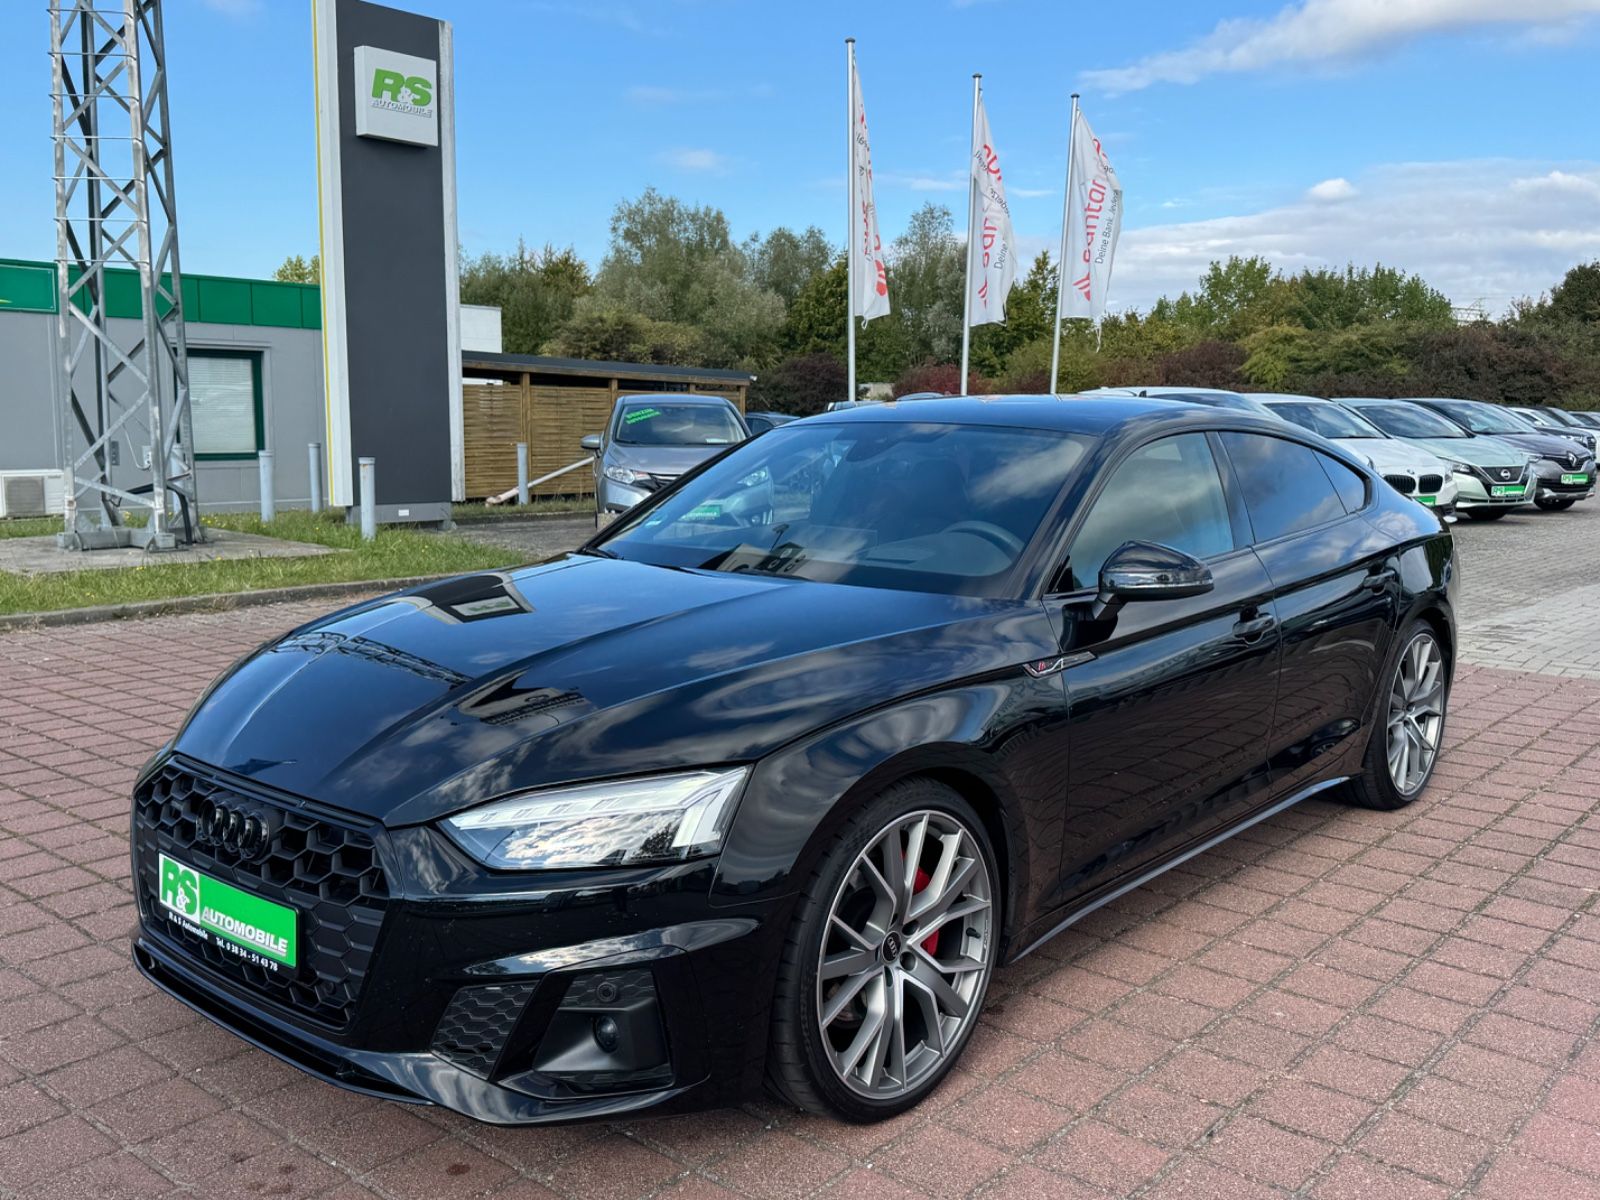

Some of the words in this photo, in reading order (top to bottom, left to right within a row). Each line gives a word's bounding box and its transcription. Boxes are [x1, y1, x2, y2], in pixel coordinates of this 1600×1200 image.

[372, 68, 432, 107] R&S
[1095, 239, 1109, 264] Deine
[162, 857, 198, 916] R&S
[201, 906, 288, 954] AUTOMOBILE
[216, 937, 225, 949] Tel.
[226, 943, 231, 951] 0
[251, 953, 260, 964] 51
